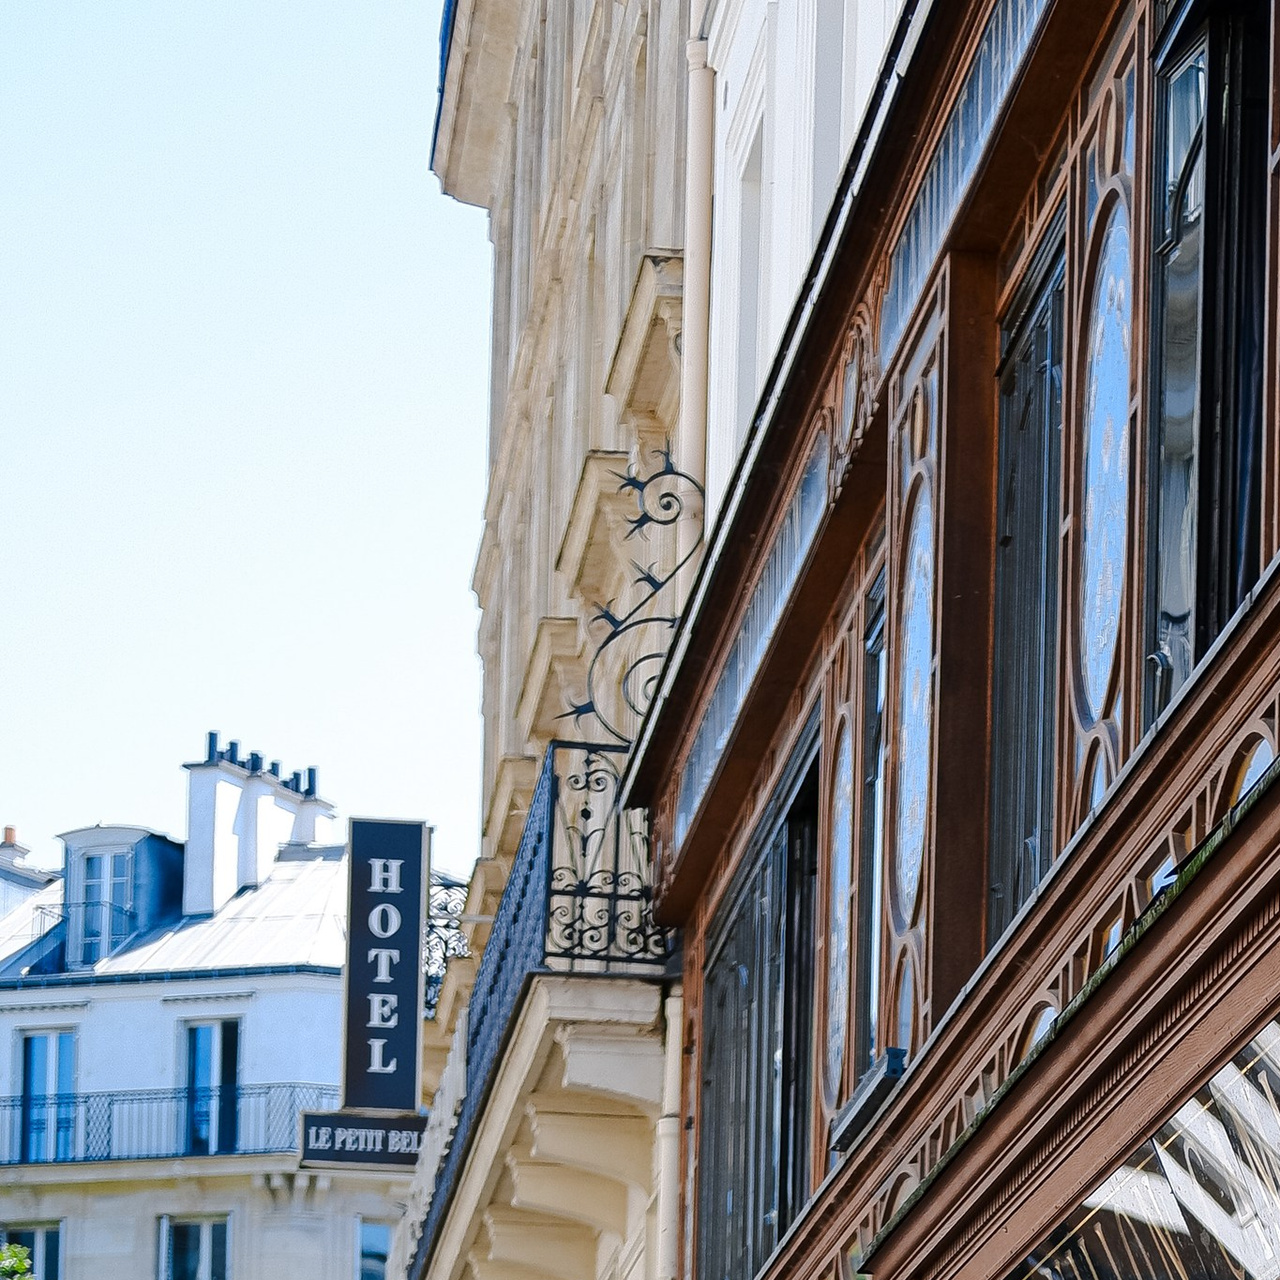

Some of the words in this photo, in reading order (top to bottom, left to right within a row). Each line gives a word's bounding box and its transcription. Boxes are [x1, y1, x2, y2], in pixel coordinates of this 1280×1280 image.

[367, 858, 405, 1074] HOTEL
[308, 1126, 332, 1150] LE
[334, 1127, 386, 1152] PETIT
